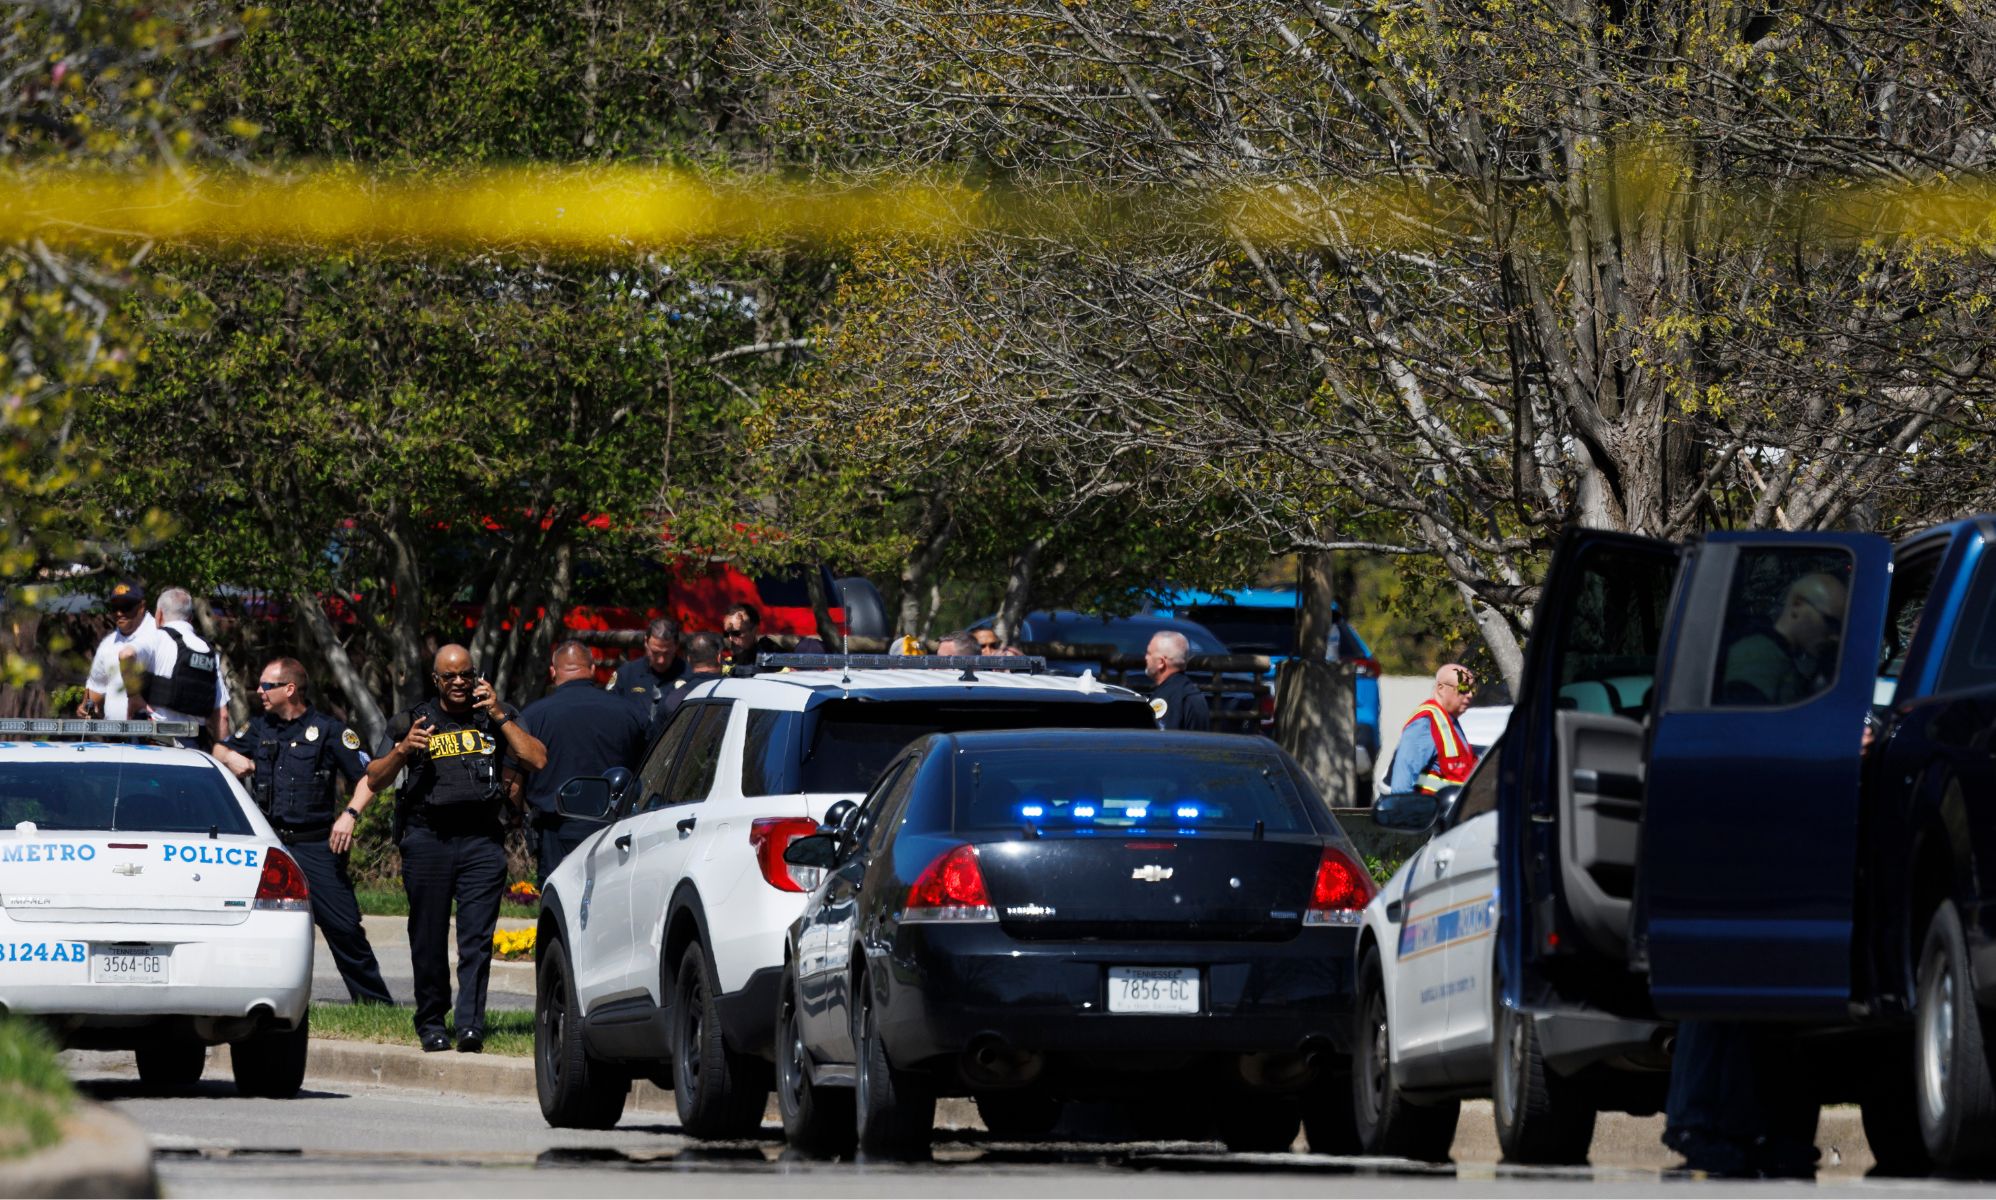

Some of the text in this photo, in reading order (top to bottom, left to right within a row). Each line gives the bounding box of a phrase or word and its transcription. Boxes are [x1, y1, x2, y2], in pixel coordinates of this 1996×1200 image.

[429, 733, 458, 747] METRO
[3, 843, 258, 867] METRO POLICE
[111, 947, 151, 956] TENNESSEE
[104, 956, 160, 973] 3564-GB
[1121, 979, 1189, 1000] 7856-GC
